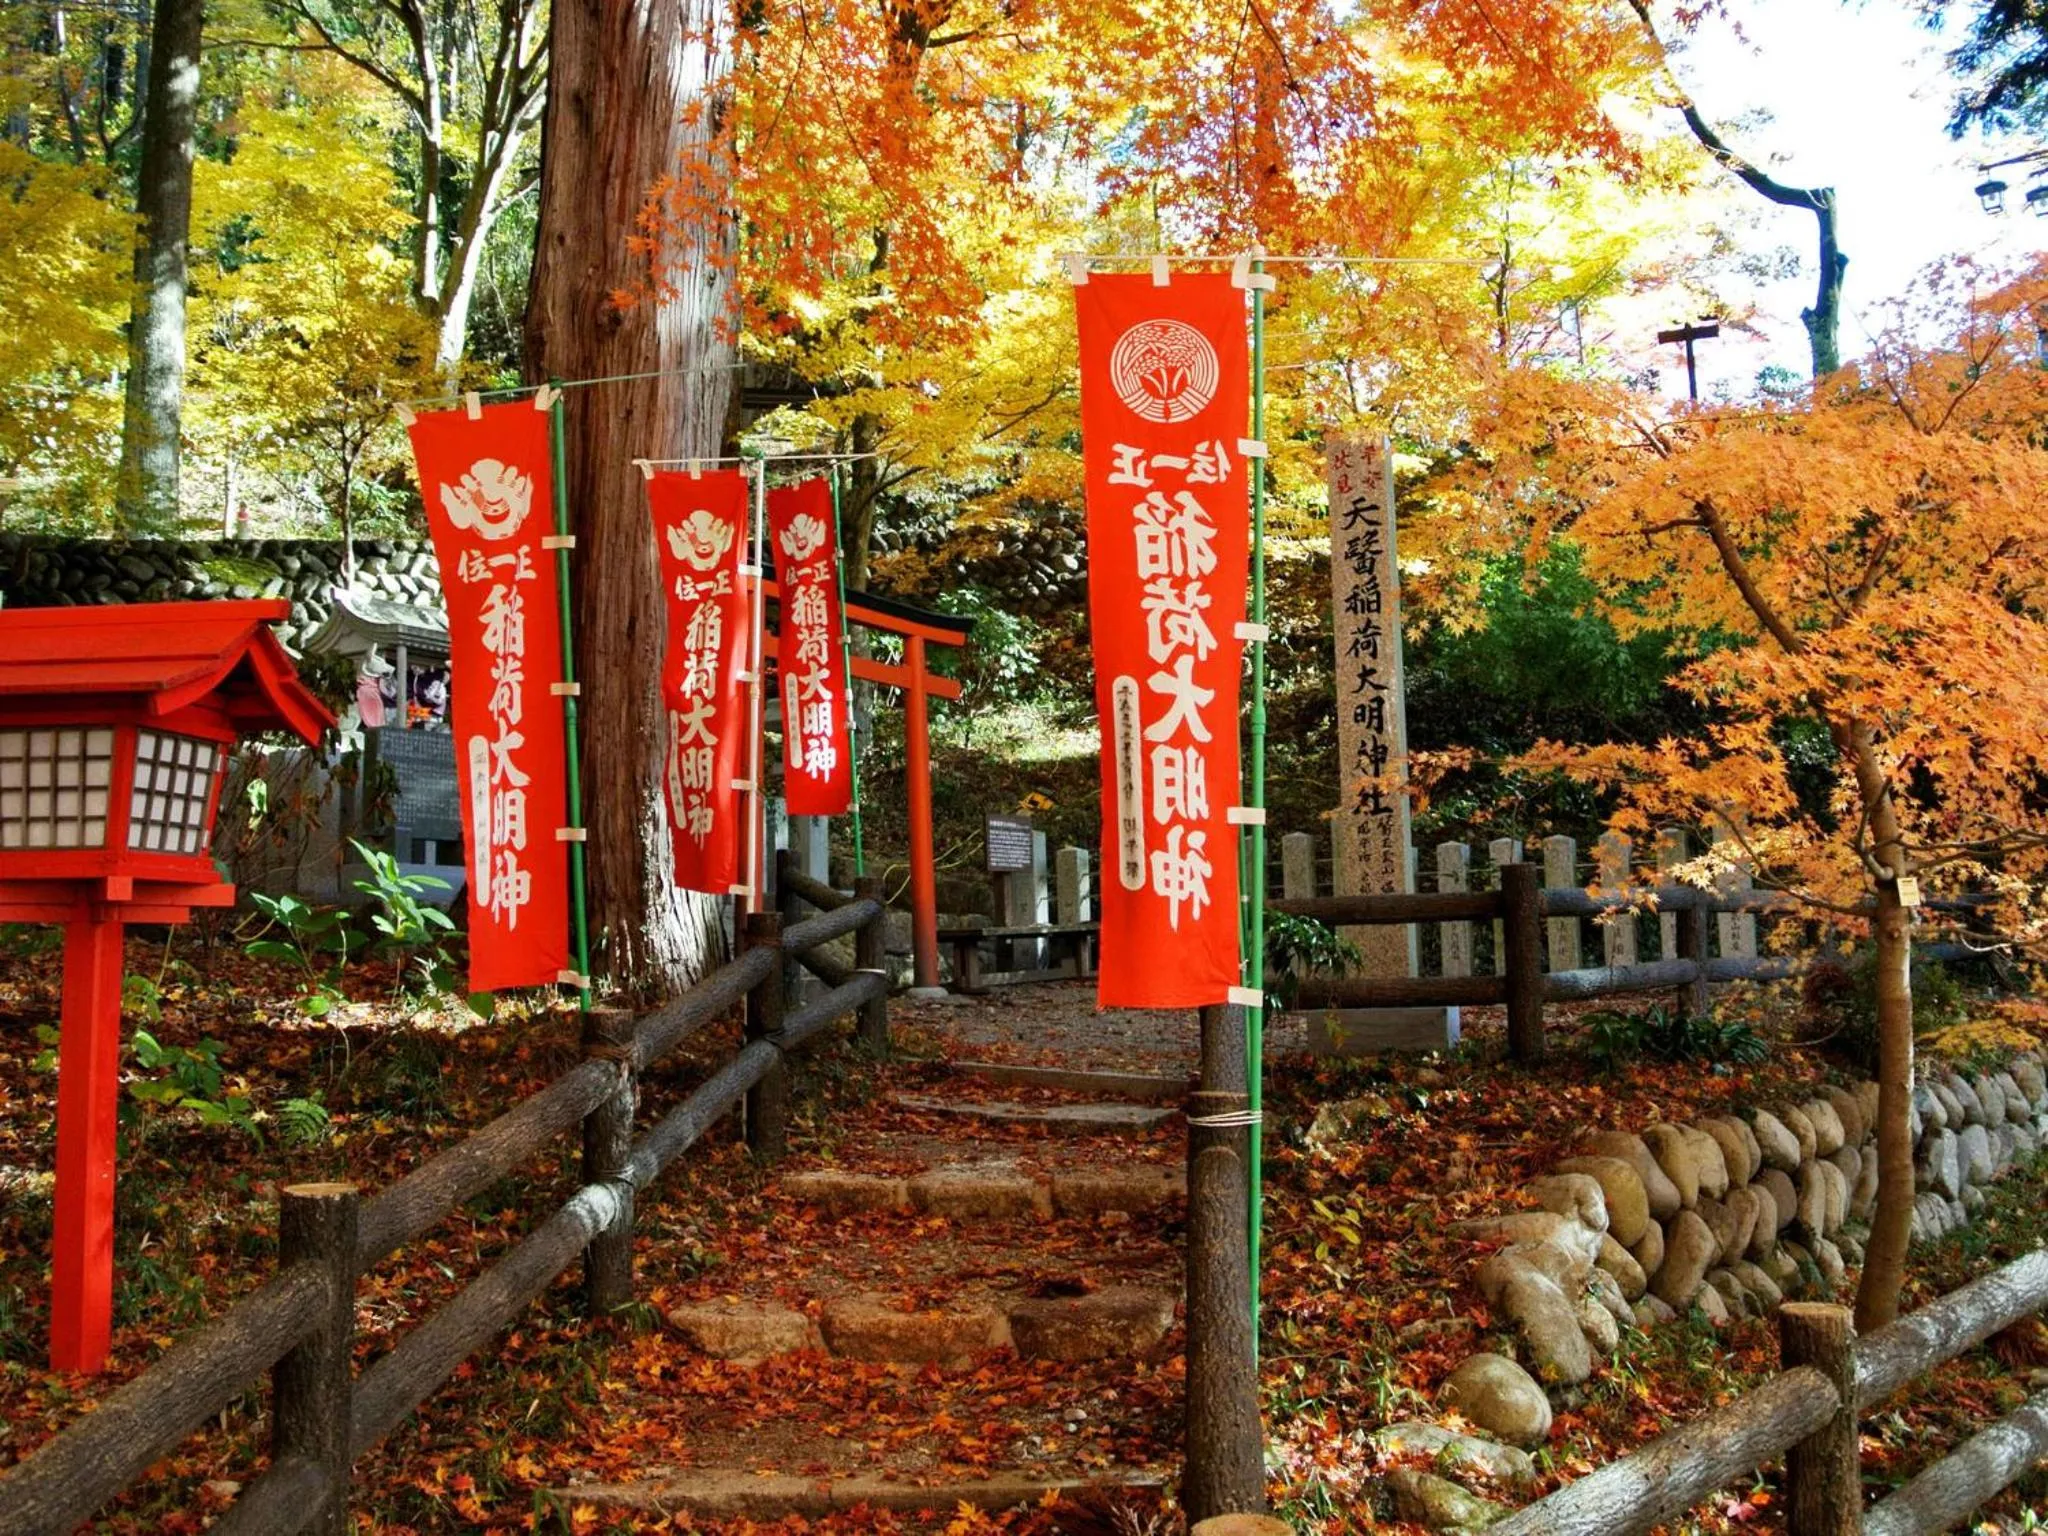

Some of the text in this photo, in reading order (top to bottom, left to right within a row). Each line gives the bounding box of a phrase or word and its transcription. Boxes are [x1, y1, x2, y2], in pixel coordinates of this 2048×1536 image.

[479, 584, 531, 931] 稲荷大明神
[680, 602, 721, 848] 稲荷大明神
[792, 585, 836, 783] 稲荷大明神
